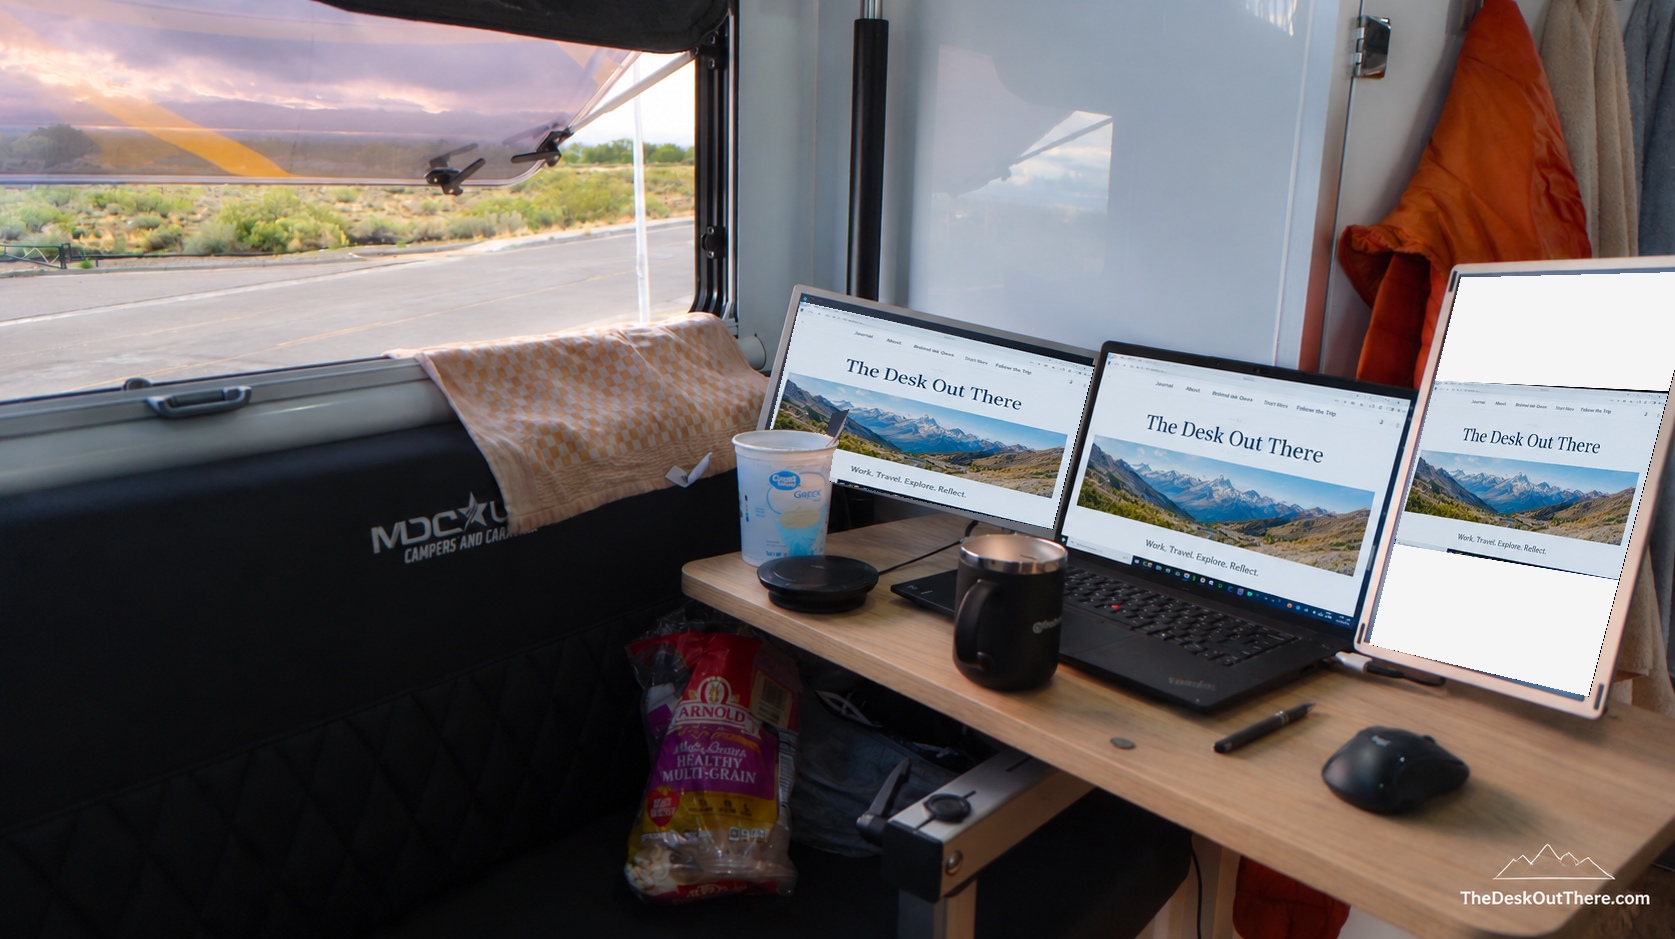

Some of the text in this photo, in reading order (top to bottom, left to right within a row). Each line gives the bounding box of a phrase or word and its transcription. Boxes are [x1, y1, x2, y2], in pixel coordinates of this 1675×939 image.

[847, 358, 1022, 411] The Desk Out There
[1147, 414, 1324, 463] The Desk Out There
[1462, 427, 1601, 454] The Desk Out There
[876, 471, 903, 484] Travel.
[904, 477, 936, 492] Explore.
[938, 485, 967, 498] Reflect.
[404, 537, 457, 564] CAMPERS
[460, 531, 482, 550] AND
[1476, 536, 1496, 546] Travel.
[1497, 540, 1522, 551] Explore.
[1524, 544, 1547, 555] Reflect.
[1169, 545, 1195, 559] Travel.
[1196, 553, 1228, 569] Explore.
[1229, 561, 1259, 577] Reflect.
[678, 704, 746, 724] ARNOLD
[677, 754, 743, 769] HEALTHY
